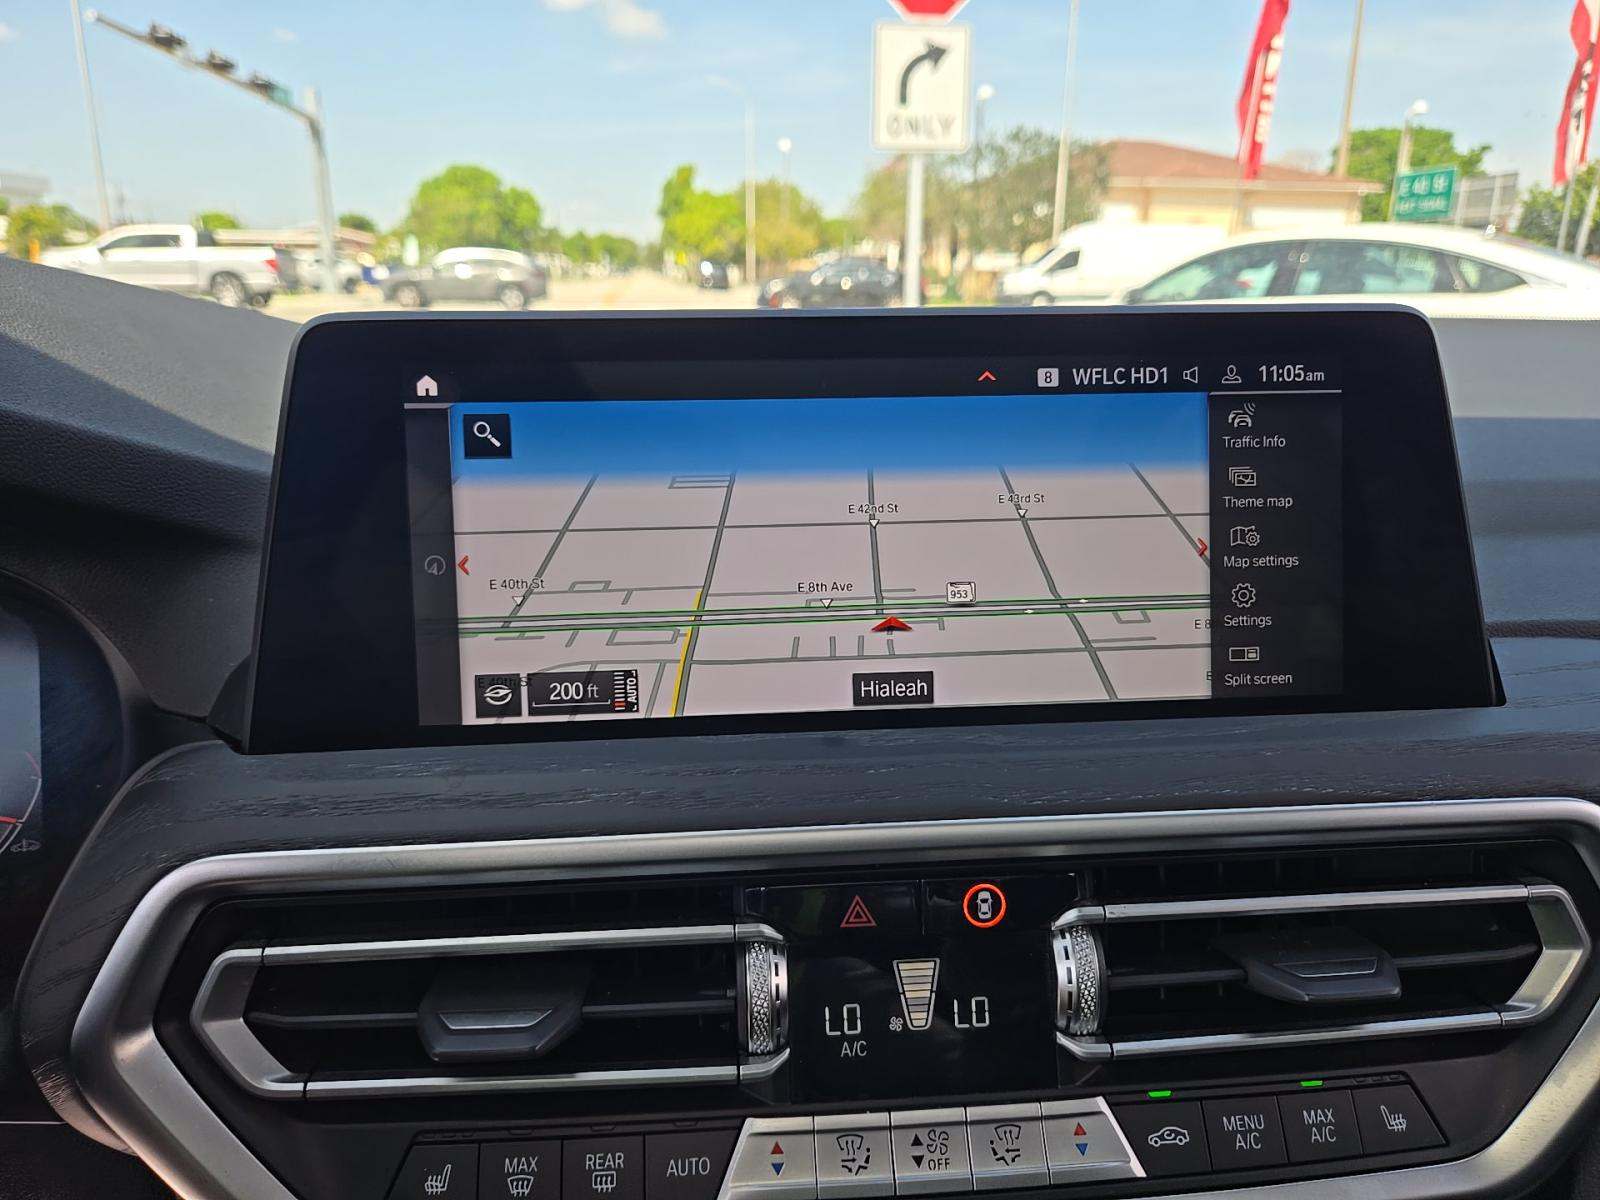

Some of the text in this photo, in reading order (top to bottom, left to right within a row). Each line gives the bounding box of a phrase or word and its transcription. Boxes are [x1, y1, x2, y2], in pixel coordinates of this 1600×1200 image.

[886, 112, 956, 139] ONLY
[1043, 371, 1053, 384] 8
[1072, 367, 1168, 386] WFLC HD1
[1222, 435, 1286, 448] Traffic Info
[998, 493, 1045, 505] E 43rd St
[1222, 496, 1294, 509] Theme map
[848, 503, 899, 514] E 42nd St
[1223, 555, 1299, 569] Map settings
[489, 578, 545, 590] E 40th St
[797, 581, 853, 593] E 8th Ave
[950, 589, 969, 600] 953
[1195, 619, 1202, 629] E
[1224, 614, 1272, 628] Settings
[1224, 672, 1293, 687] Split screen
[549, 682, 599, 701] 200 ft
[626, 677, 638, 703] AUTO
[860, 678, 929, 698] Hialeah
[840, 1040, 868, 1058] A/C
[1222, 1114, 1265, 1132] MENU
[1303, 1108, 1335, 1125] MAX
[1235, 1132, 1262, 1151] A/C
[1311, 1126, 1337, 1144] A/C
[504, 1156, 538, 1174] MAX
[585, 1152, 624, 1171] REAR
[666, 1157, 711, 1178] AUTO
[927, 1157, 951, 1172] OFF
